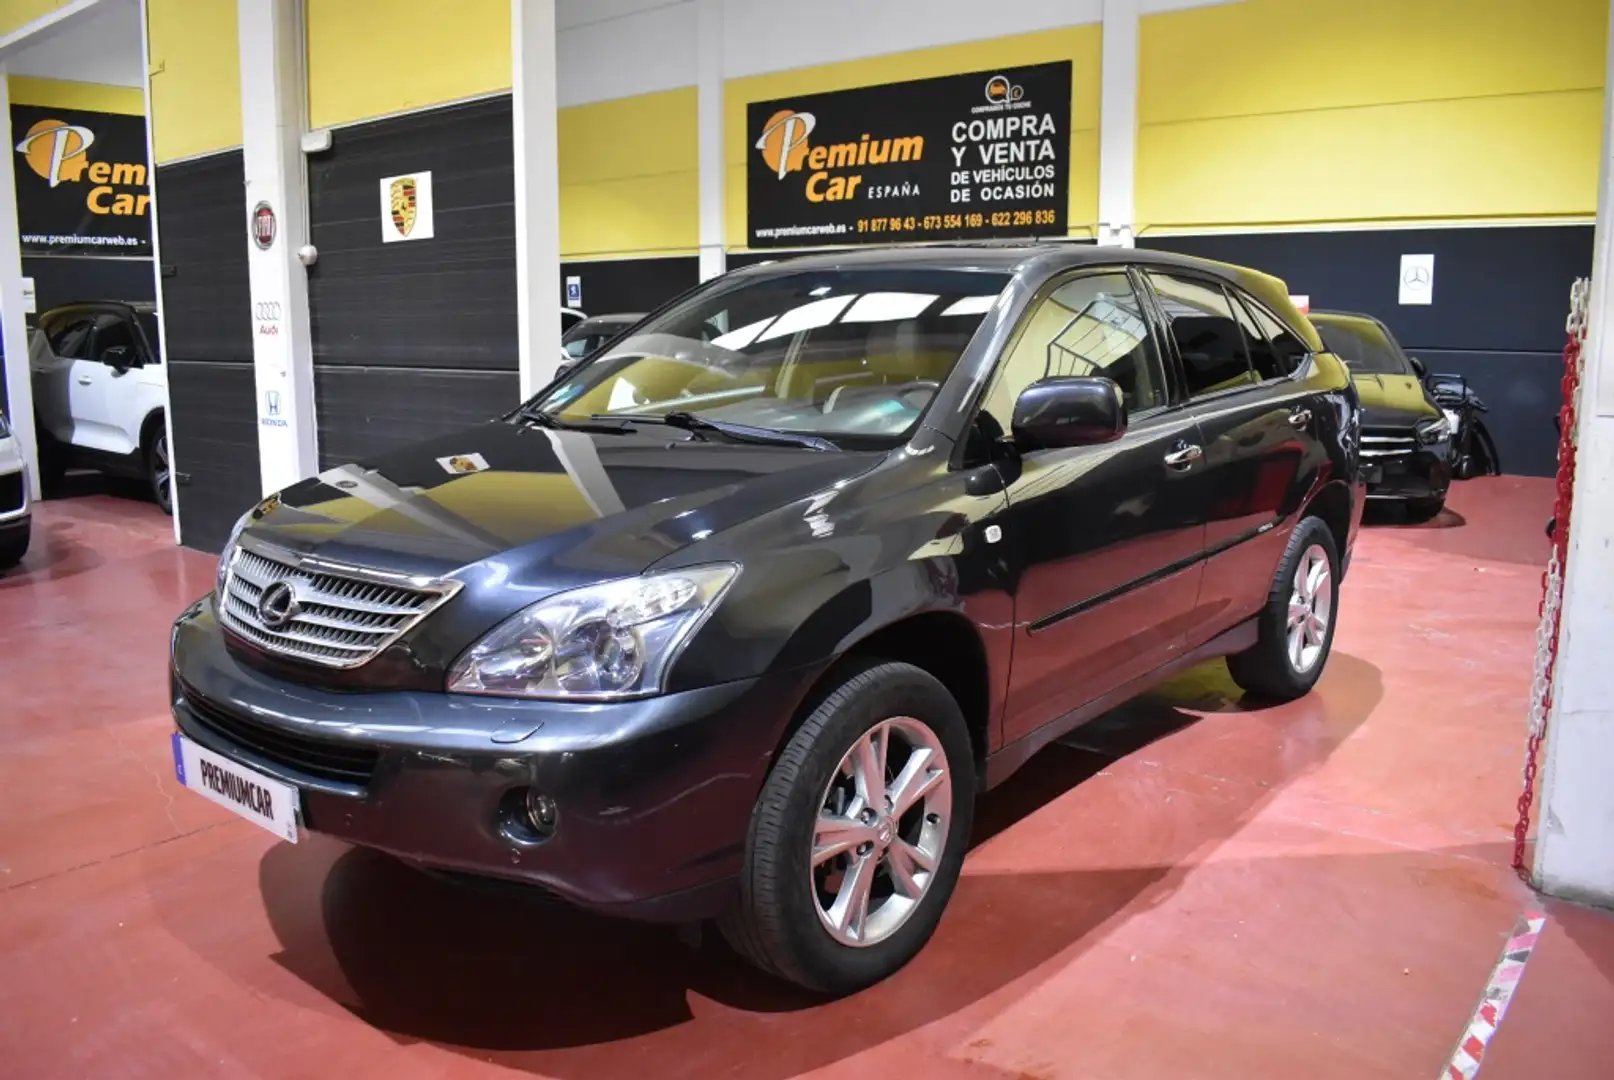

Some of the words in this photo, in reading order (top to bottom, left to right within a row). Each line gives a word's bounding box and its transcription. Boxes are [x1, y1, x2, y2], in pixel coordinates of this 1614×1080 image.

[951, 113, 1056, 143] COMPRA
[15, 125, 150, 188] Prem
[755, 112, 924, 181] Premium
[951, 146, 967, 167] Y
[979, 139, 1056, 165] VENTA
[805, 171, 862, 203] Car
[950, 171, 970, 186] DE
[973, 164, 1055, 184] VEHÍCULOS
[86, 185, 151, 216] Car
[868, 181, 920, 199] ESPAÑA
[950, 188, 971, 203] DE
[980, 180, 1055, 201] OCASIÓN
[755, 222, 846, 239] www.premiumcarweb.es
[857, 219, 868, 233] 91
[871, 217, 888, 232] 877
[889, 217, 902, 231] 96
[903, 216, 915, 231] 43
[923, 214, 941, 230] 673
[943, 214, 962, 229] 554
[991, 212, 1011, 227] 622
[1013, 211, 1032, 226] 296
[1035, 210, 1056, 225] 836
[22, 233, 138, 246] www.premiumcarweb.es
[259, 323, 279, 336] Audi
[200, 758, 275, 821] PREMIUMCAR
